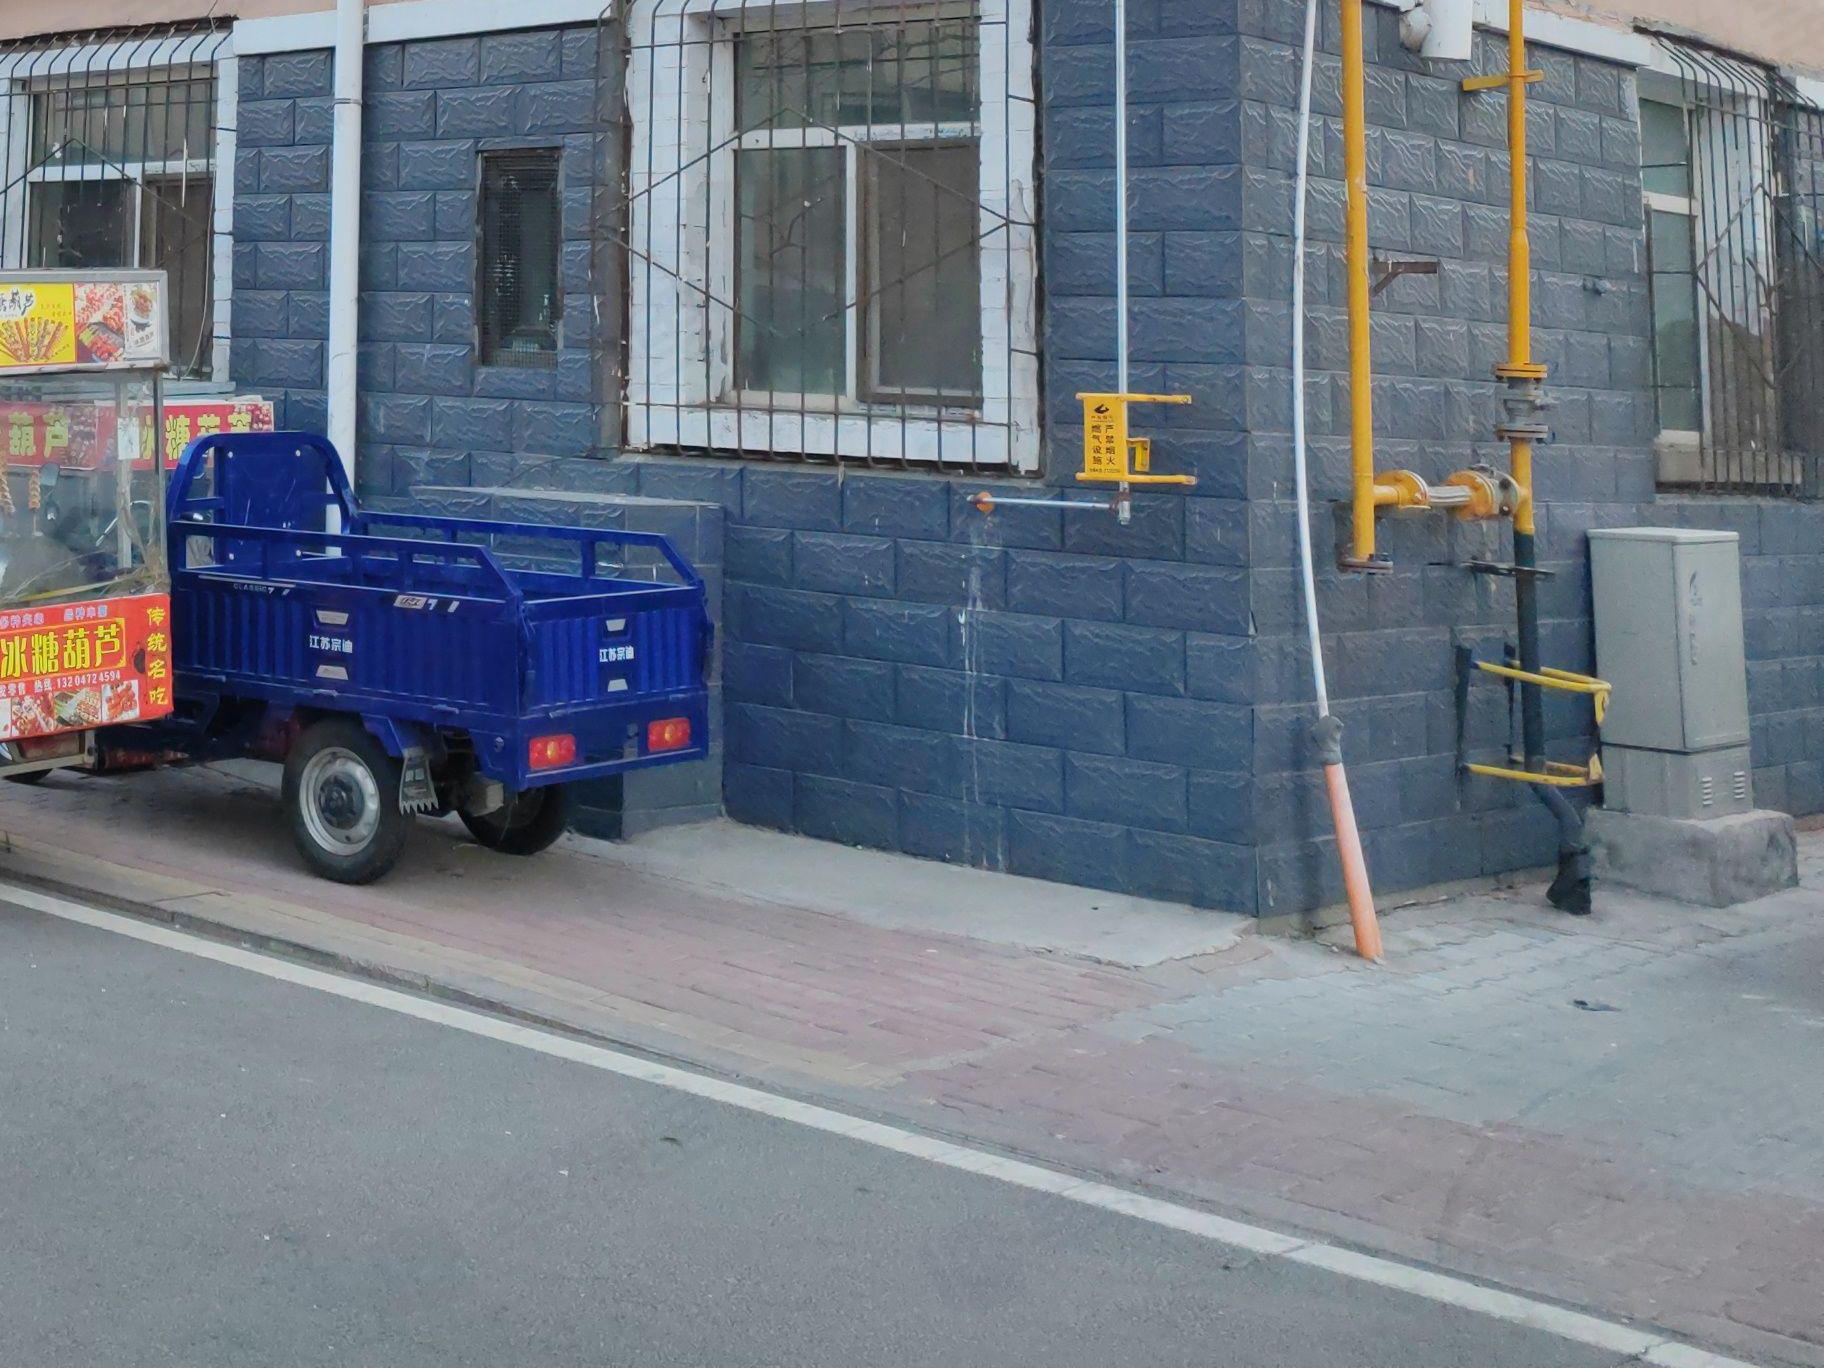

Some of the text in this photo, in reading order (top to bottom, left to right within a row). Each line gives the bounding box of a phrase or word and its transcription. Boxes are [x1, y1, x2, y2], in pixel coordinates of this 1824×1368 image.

[0, 623, 121, 679] 冰糖葫芦
[146, 605, 169, 706] 传统名吃
